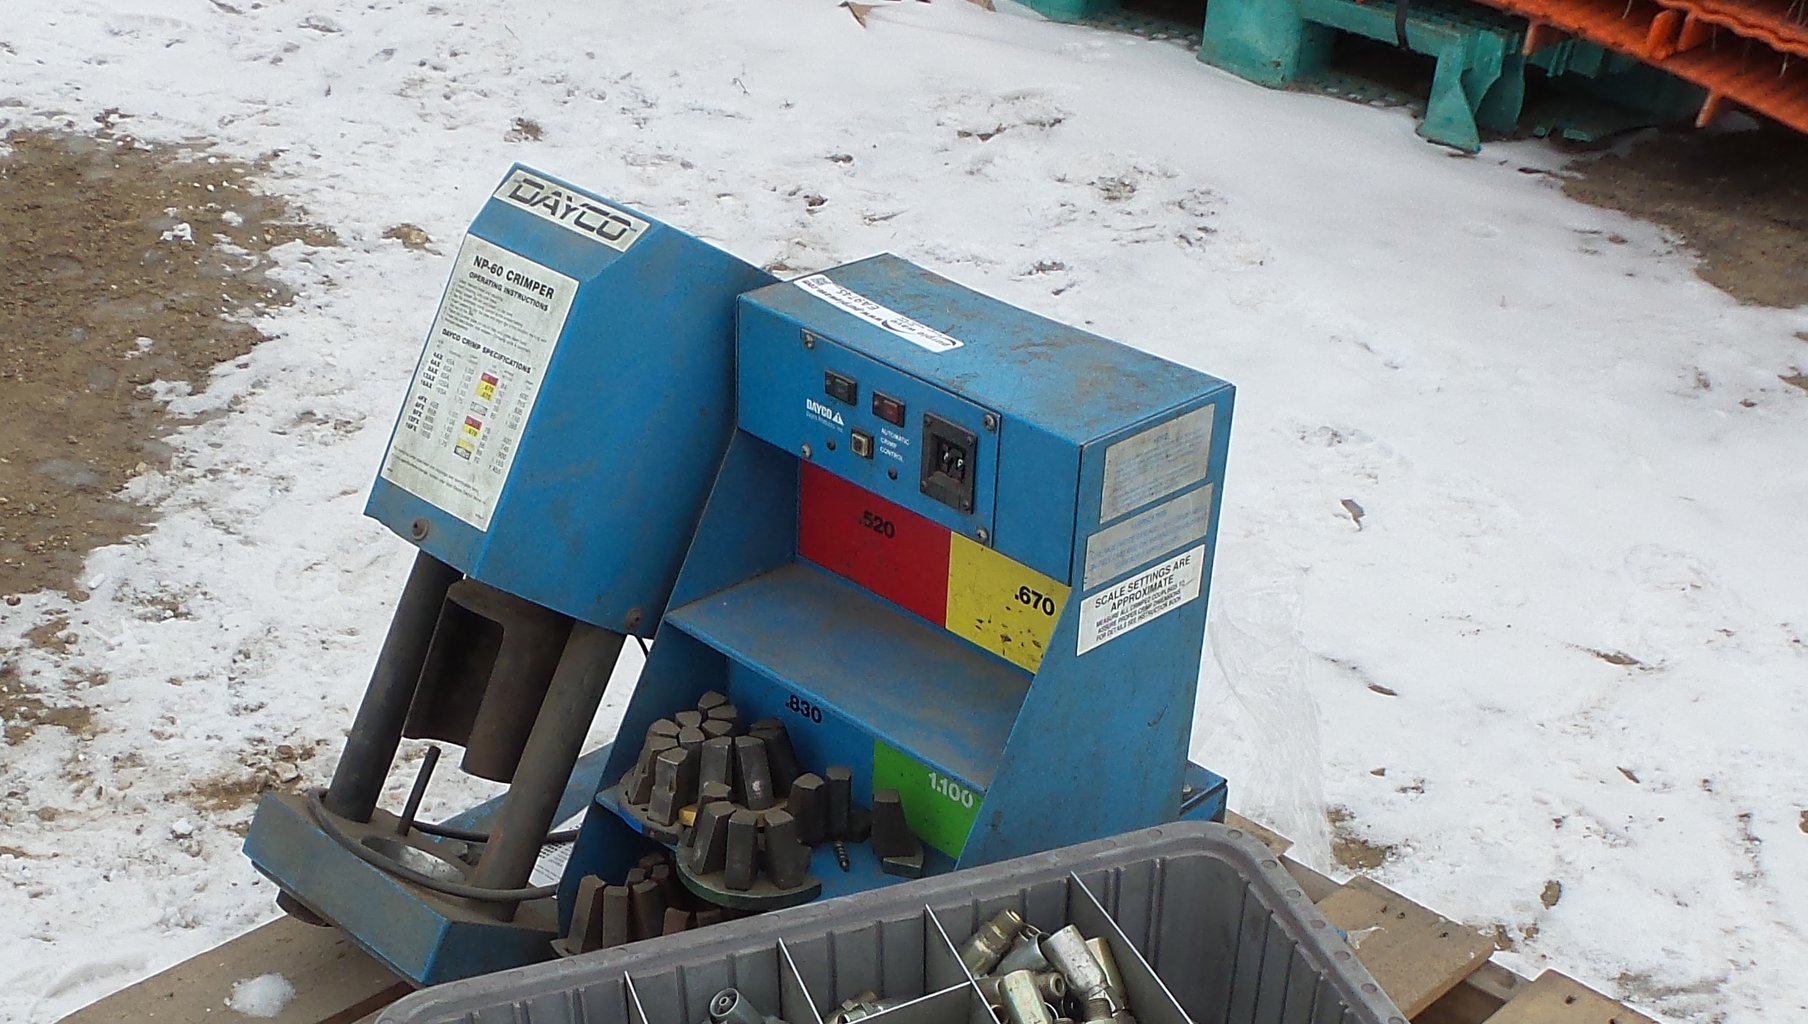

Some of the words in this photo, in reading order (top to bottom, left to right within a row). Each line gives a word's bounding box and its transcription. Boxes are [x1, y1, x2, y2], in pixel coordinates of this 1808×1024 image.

[508, 178, 632, 242] DAYCO
[469, 271, 502, 292] OPERATING
[503, 286, 549, 312] INSTRUCTIONS
[473, 255, 504, 277] NP-60
[505, 270, 555, 300] CRIMPER
[441, 328, 461, 342] DAYCO
[461, 337, 481, 350] CRIMP
[482, 346, 532, 374] SPECIFICATIONS
[806, 398, 832, 420] DAYCO
[1014, 585, 1055, 616] .670
[1095, 585, 1126, 609] SCALE
[1127, 564, 1171, 593] SETTINGS
[1173, 555, 1191, 572] ARE
[1110, 574, 1174, 613] APPROXIMATE
[784, 694, 822, 724] .830
[928, 771, 974, 809] 1.100
